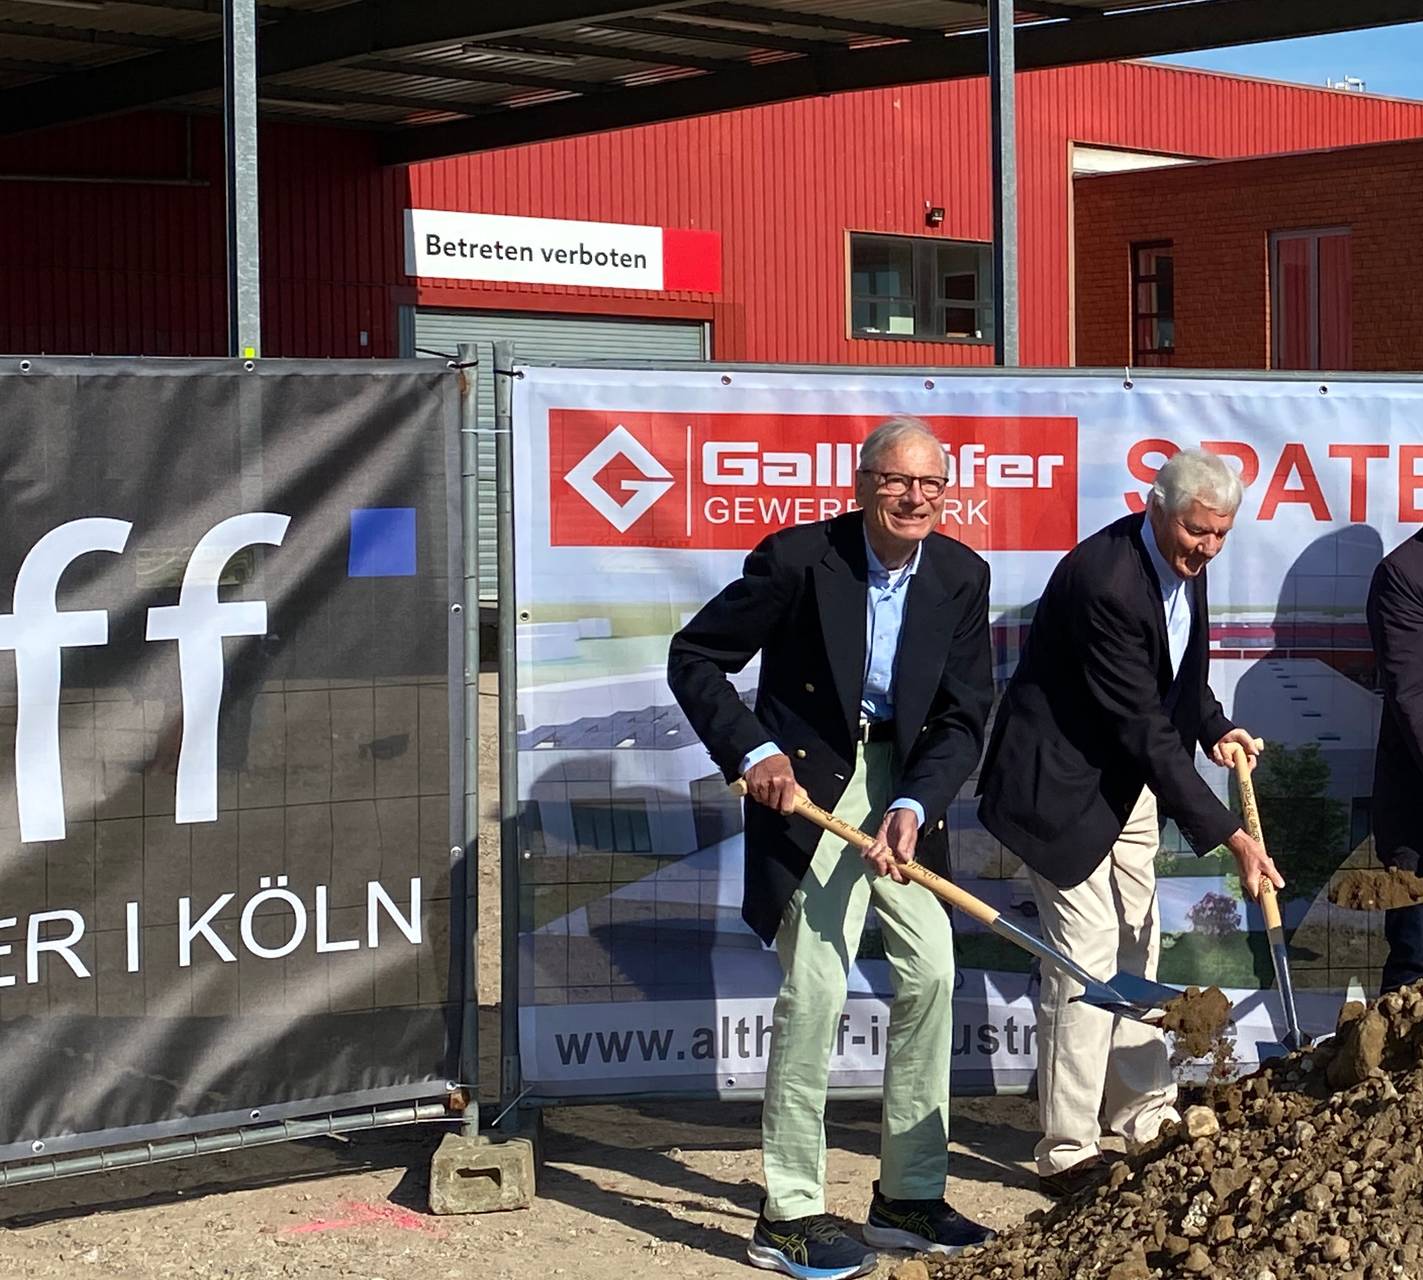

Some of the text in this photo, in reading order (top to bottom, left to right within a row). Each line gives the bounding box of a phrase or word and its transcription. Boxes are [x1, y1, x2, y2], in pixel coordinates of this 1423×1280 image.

[426, 234, 648, 269] Betreten verboten
[702, 441, 1063, 488] Gallfer
[704, 496, 990, 526] GEWERRK
[179, 875, 422, 967] KÖLN
